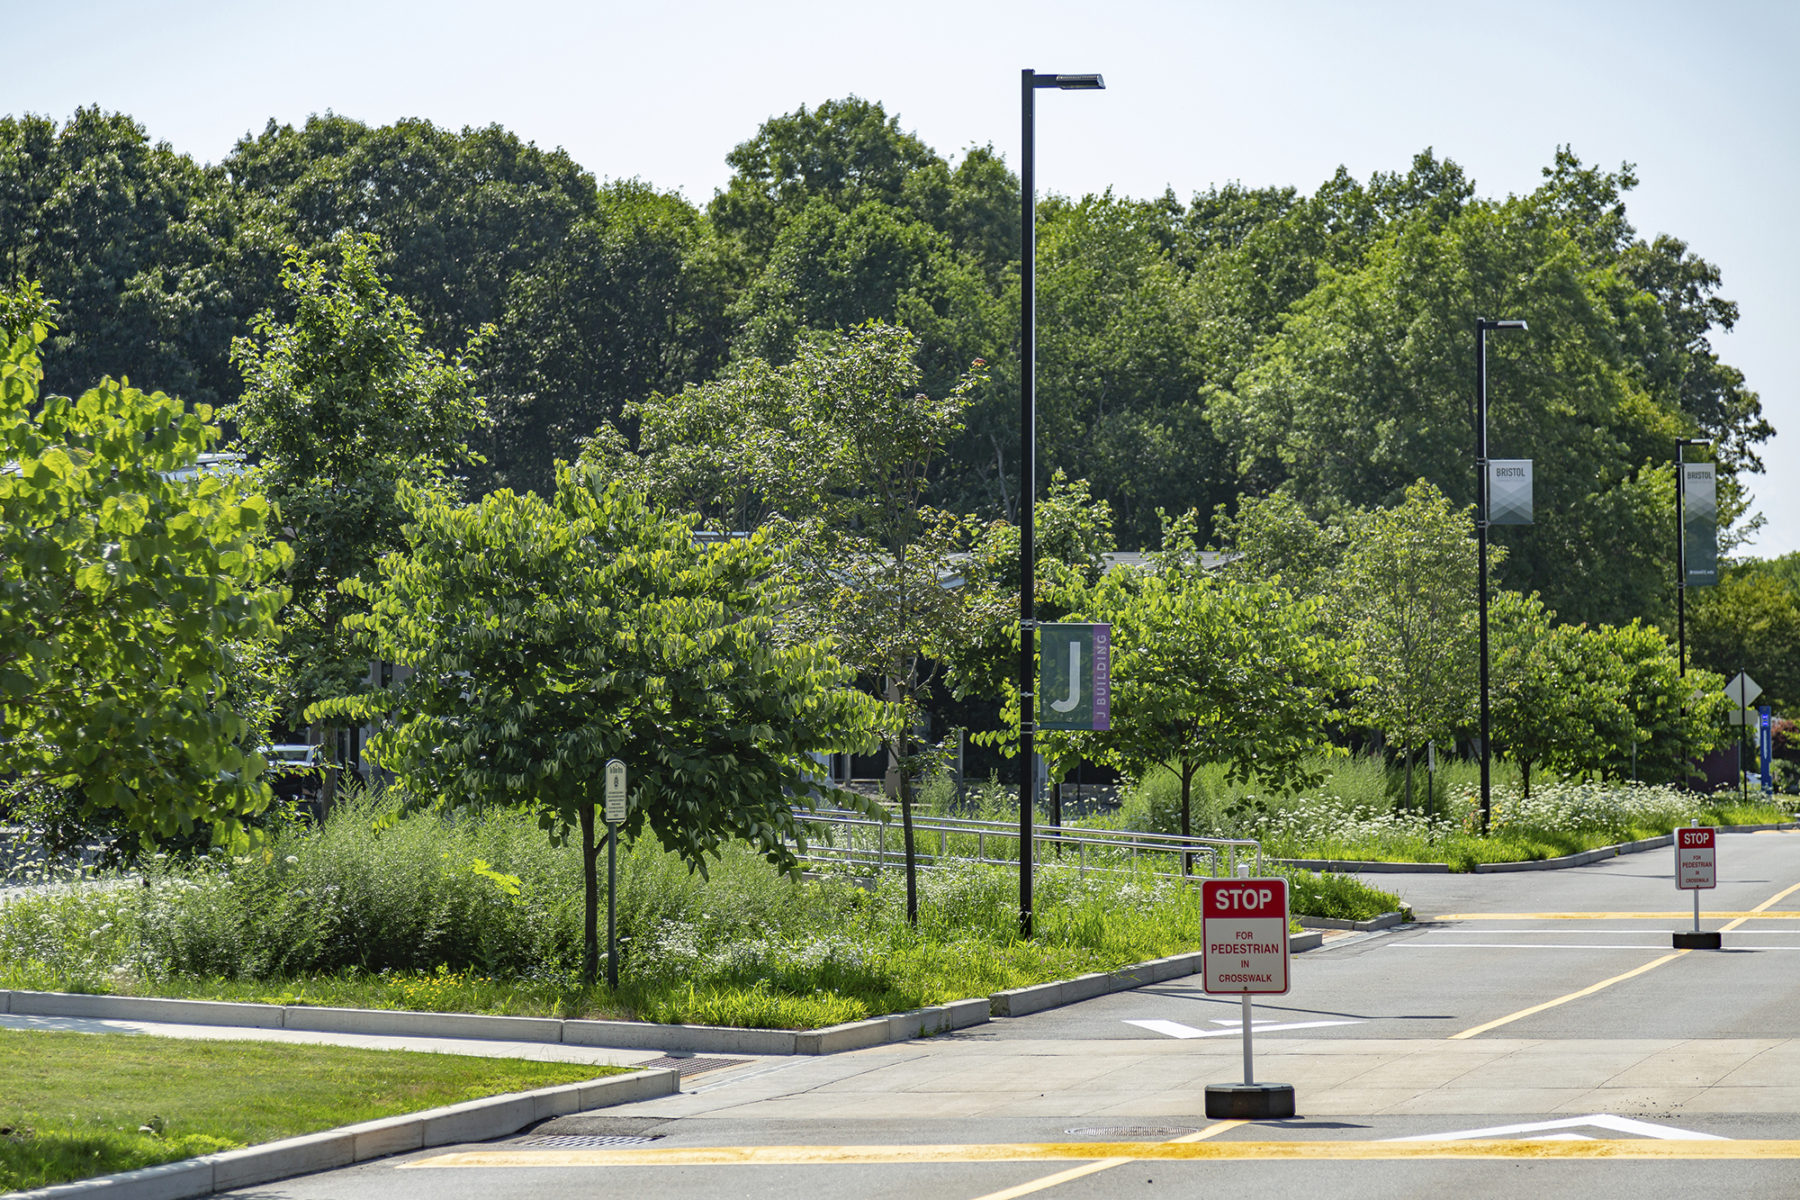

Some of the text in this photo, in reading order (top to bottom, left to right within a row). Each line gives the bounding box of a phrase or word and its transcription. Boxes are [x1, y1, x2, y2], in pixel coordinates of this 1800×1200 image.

[1496, 467, 1525, 477] BRISTOL
[1687, 471, 1712, 479] BRISTOL
[1096, 634, 1107, 706] BUILDING
[1050, 641, 1081, 713] J
[1684, 832, 1710, 845] STOP
[1216, 889, 1272, 910] STOP
[1235, 931, 1254, 940] FOR
[1211, 944, 1279, 954] PEDESTRIAN
[1240, 960, 1250, 969] IN
[1218, 974, 1272, 983] CROSSWALK
